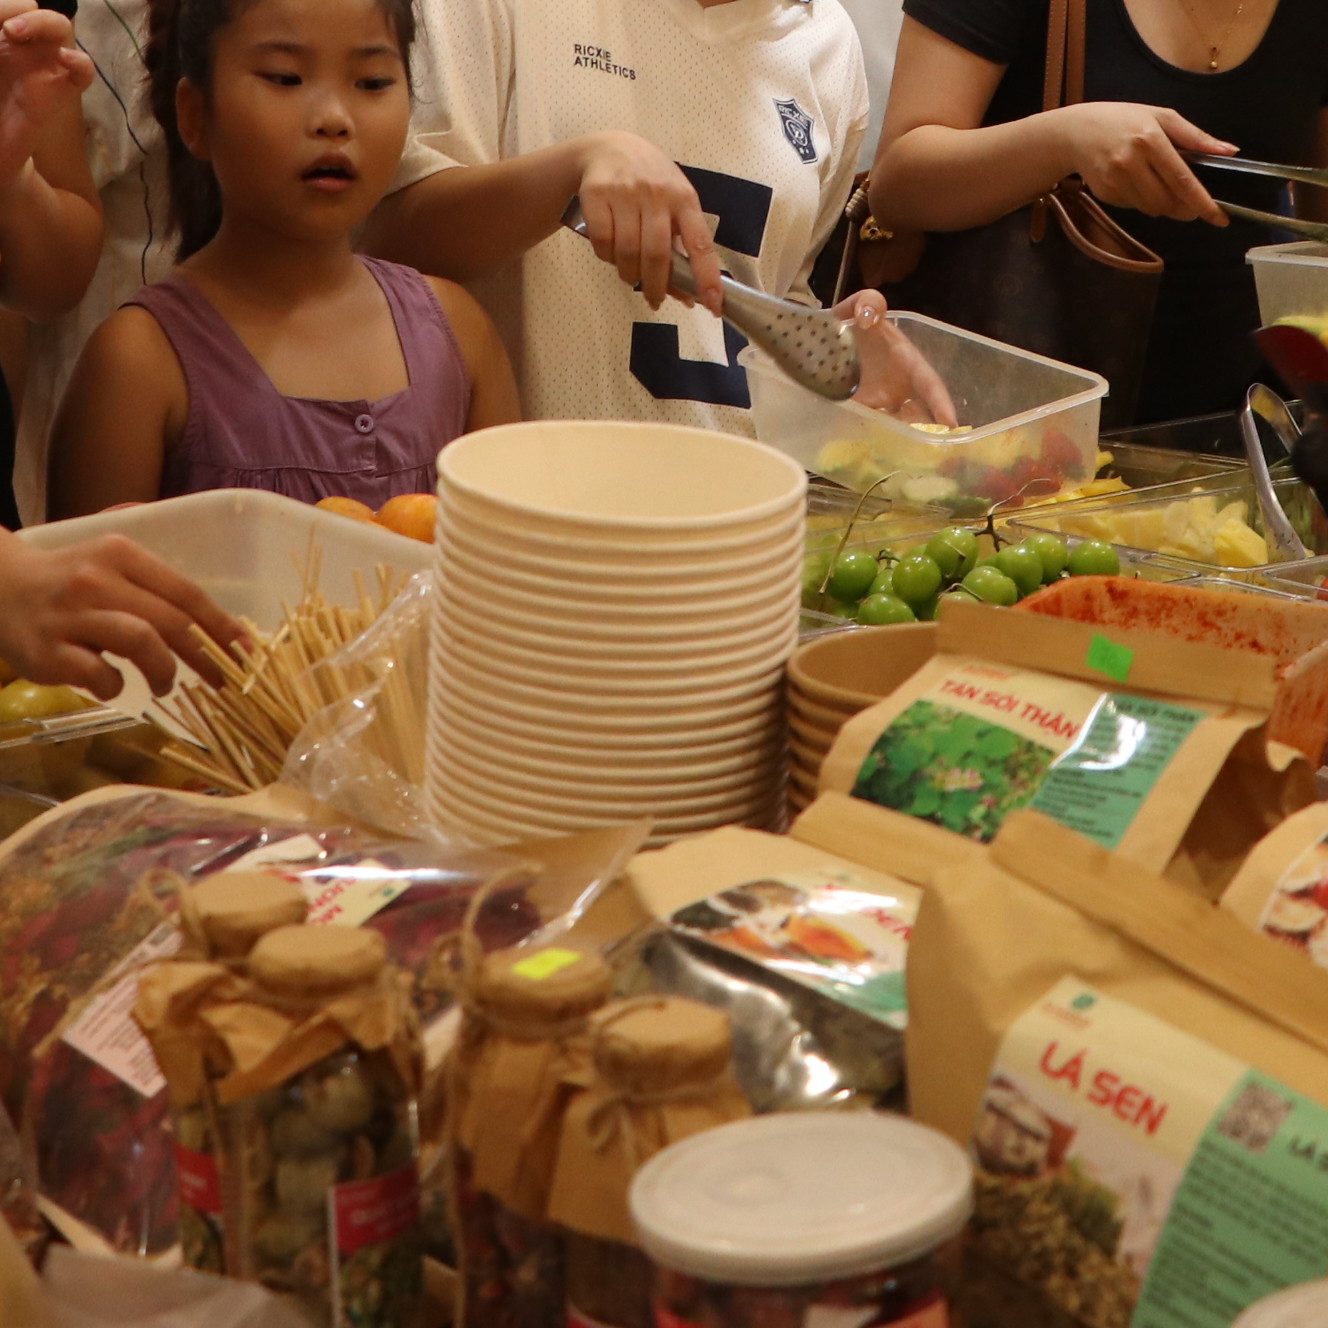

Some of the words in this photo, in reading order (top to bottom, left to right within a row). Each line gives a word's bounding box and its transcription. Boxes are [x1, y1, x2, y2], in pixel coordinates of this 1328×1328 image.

[574, 43, 612, 62] RICXIE
[574, 56, 636, 80] ATHLETICS
[1039, 1040, 1089, 1091] LÁ
[1085, 1069, 1170, 1137] SEN
